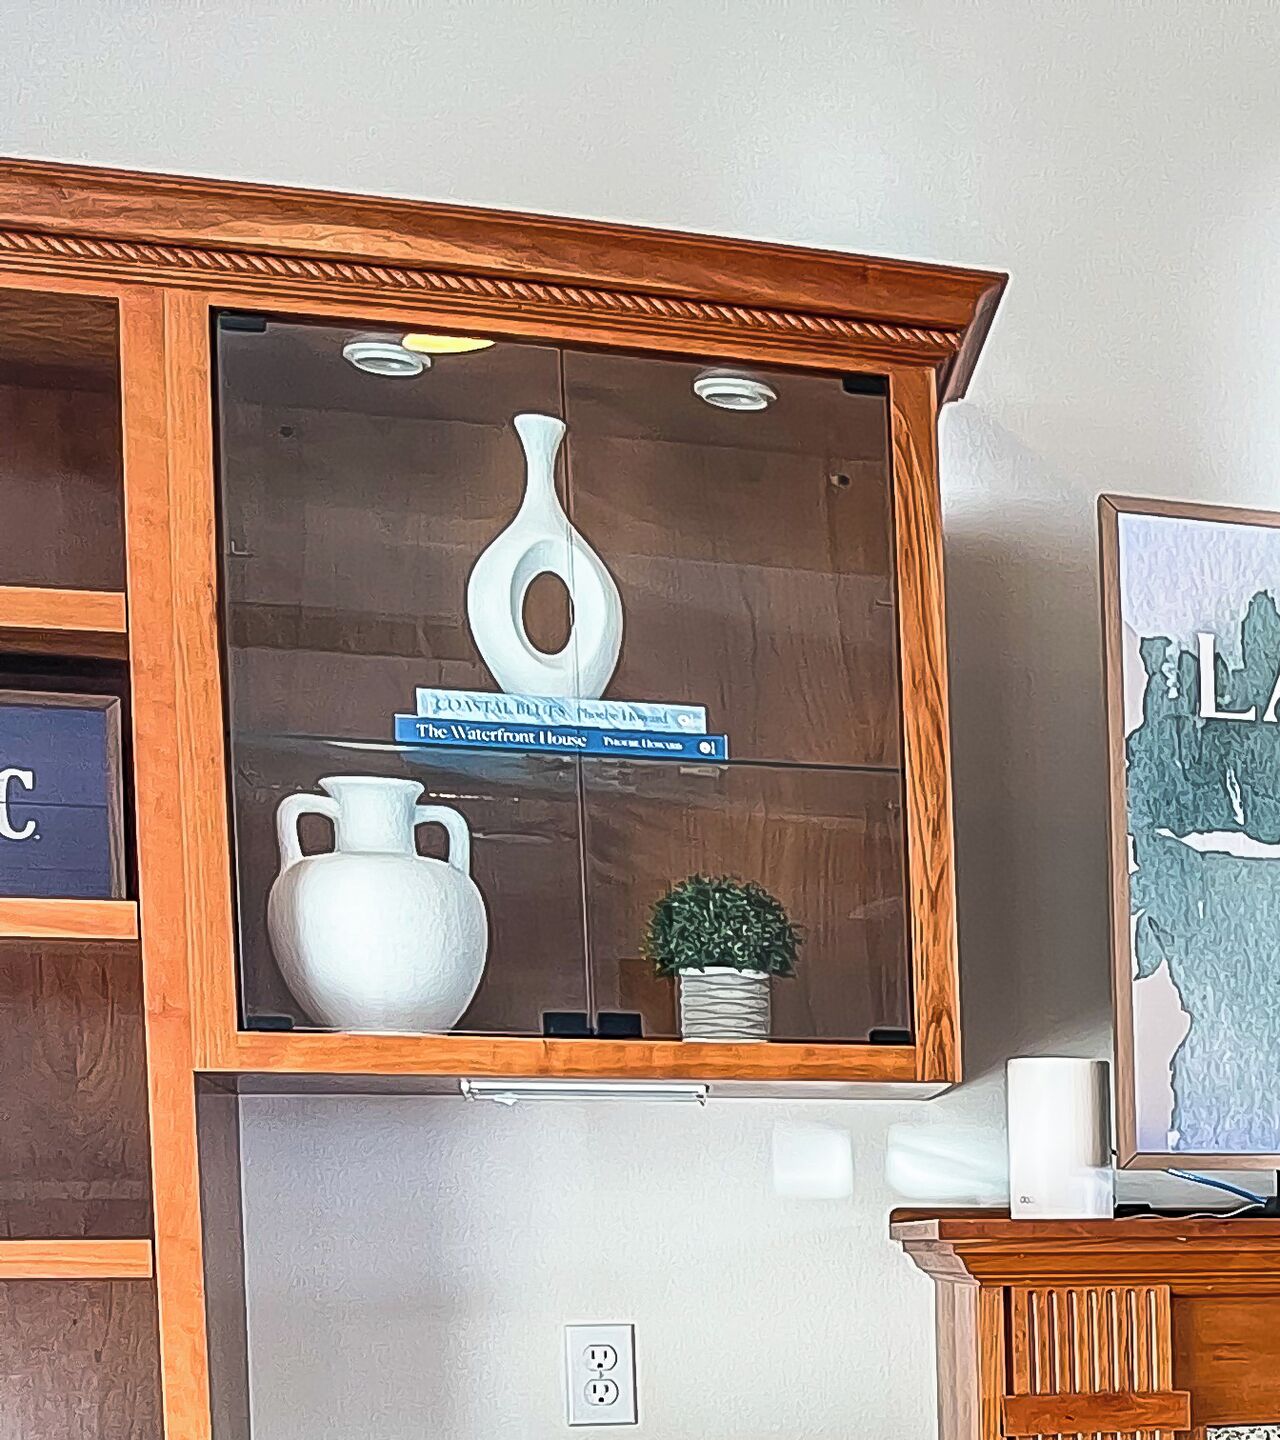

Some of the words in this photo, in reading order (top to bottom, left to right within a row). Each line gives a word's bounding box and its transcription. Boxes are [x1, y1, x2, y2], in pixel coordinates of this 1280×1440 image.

[415, 722, 448, 739] The
[450, 724, 535, 744] Waterfront
[539, 730, 587, 748] House
